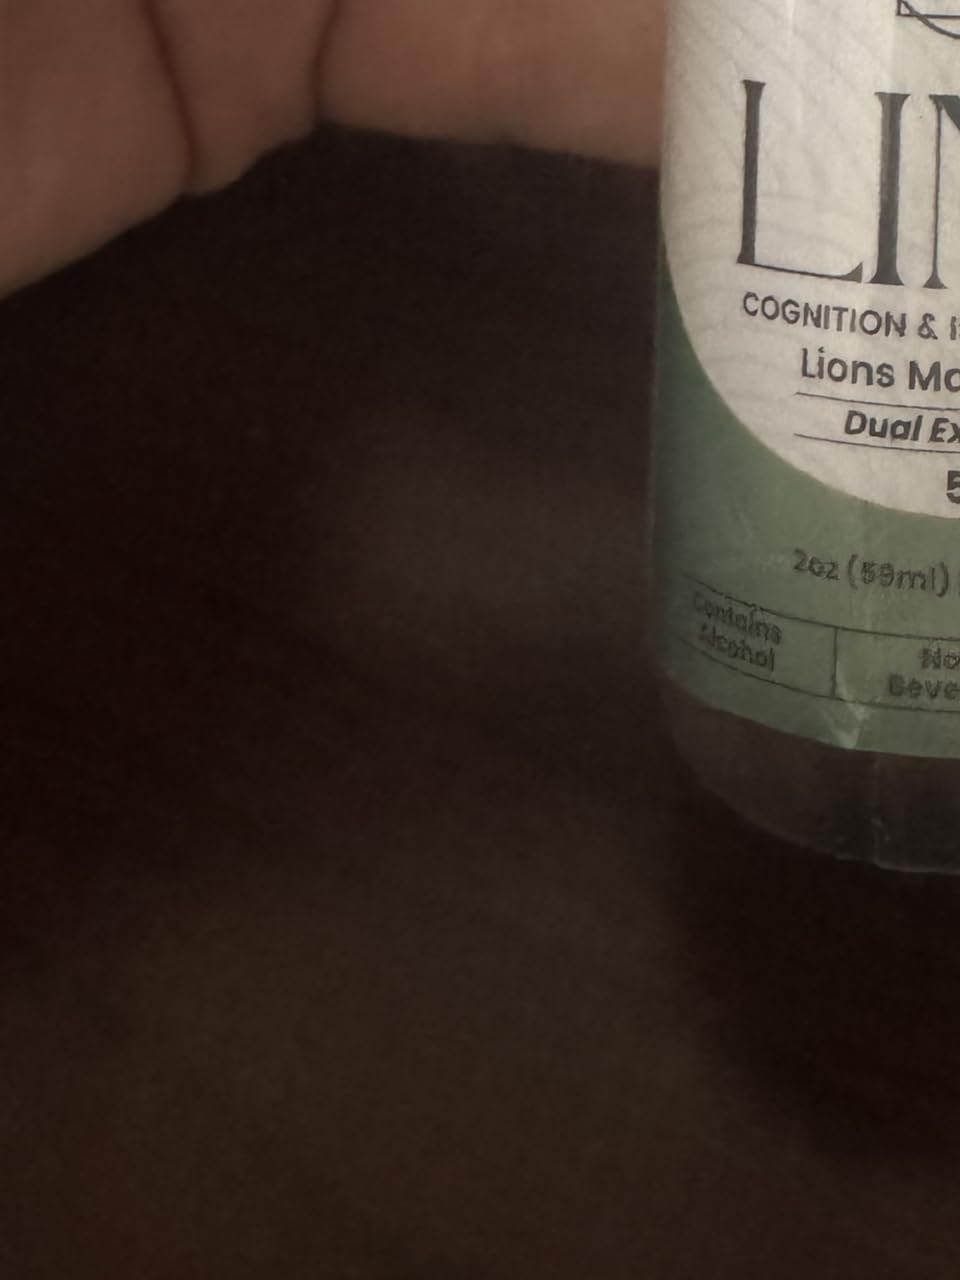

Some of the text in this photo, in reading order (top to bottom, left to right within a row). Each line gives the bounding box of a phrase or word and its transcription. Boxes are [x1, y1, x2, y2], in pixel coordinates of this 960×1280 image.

[743, 291, 907, 337] COGNITION
[917, 313, 938, 340] &
[801, 346, 895, 388] Lions
[844, 410, 923, 441] Dual
[794, 549, 840, 581] 2oz
